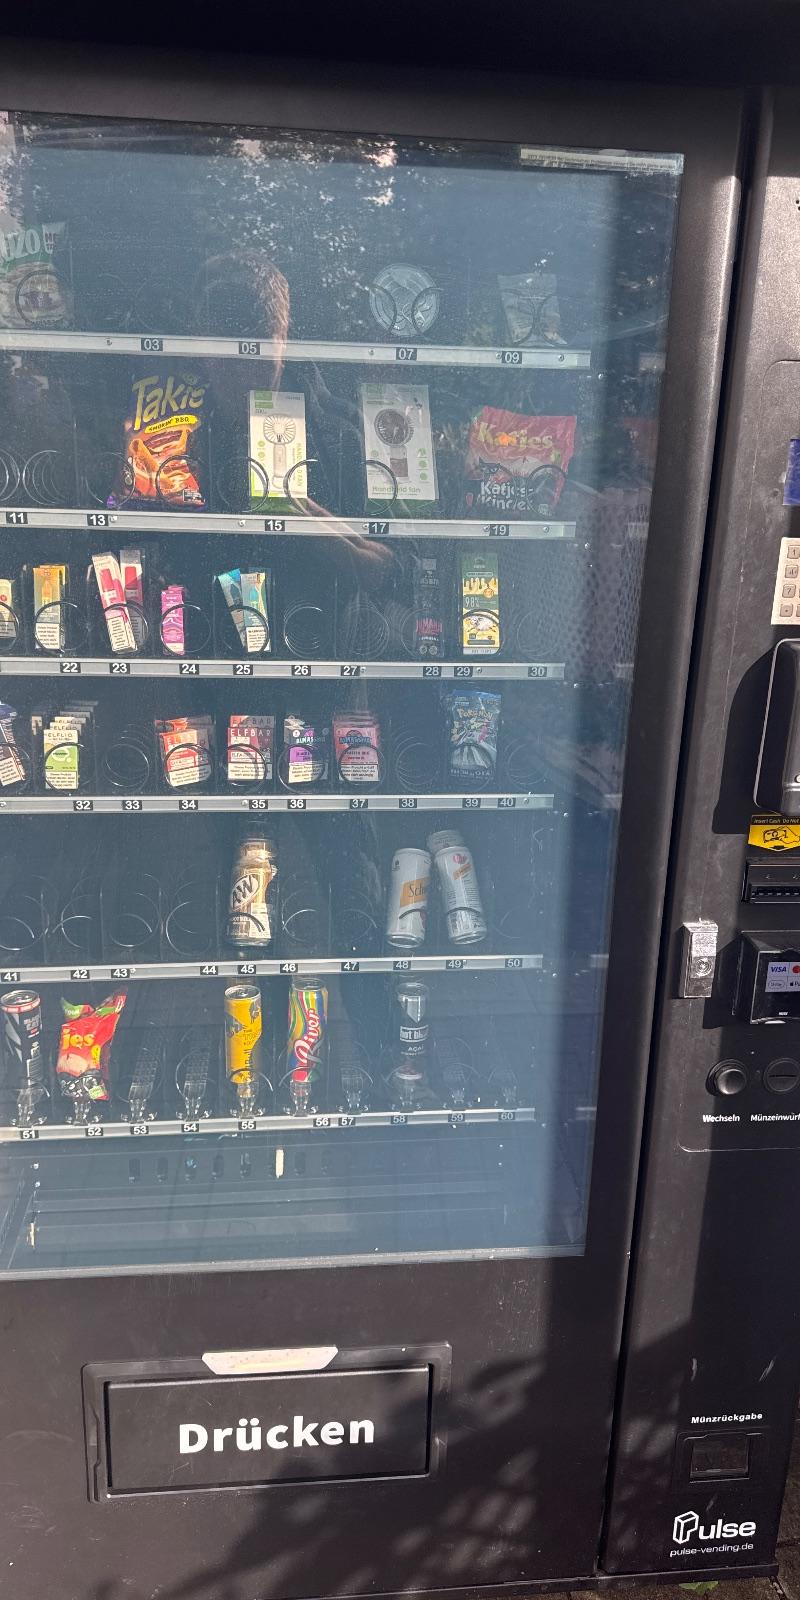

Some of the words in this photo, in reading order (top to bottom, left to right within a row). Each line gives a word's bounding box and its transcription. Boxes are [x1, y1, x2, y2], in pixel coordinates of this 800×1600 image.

[143, 339, 160, 351] 03
[241, 342, 257, 355] 05
[398, 347, 415, 360] 07
[504, 351, 520, 363] 09
[10, 512, 25, 523] 11
[89, 515, 106, 525] 13
[267, 520, 283, 531] 15
[371, 523, 387, 533] 17
[492, 525, 507, 536] 19
[62, 663, 78, 673] 22
[112, 664, 127, 673] 23
[181, 664, 197, 674] 24
[236, 665, 251, 675] 25
[294, 665, 309, 675] 26
[343, 666, 358, 675] 27
[425, 667, 440, 676] 28
[456, 667, 471, 677] 29
[531, 667, 545, 677] 30
[76, 800, 91, 810] 32
[125, 800, 140, 810] 33
[181, 800, 197, 810] 34
[251, 799, 266, 809] 35
[290, 799, 304, 808] 36
[351, 799, 366, 808] 37
[401, 799, 415, 808] 38
[465, 798, 479, 808] 39
[500, 798, 514, 807] 40
[282, 963, 296, 973] 46
[343, 961, 357, 971] 47
[395, 960, 409, 969] 48
[447, 959, 461, 969] 49
[507, 958, 520, 968] 50
[73, 969, 88, 979] 42
[113, 968, 128, 978] 43
[202, 965, 217, 974] 44
[240, 964, 255, 974] 45
[3, 971, 18, 981] 41
[392, 1114, 406, 1123] 58
[450, 1113, 463, 1122] 59
[500, 1112, 514, 1120] 60
[702, 1114, 740, 1123] Wechseln
[241, 1120, 255, 1130] 55
[315, 1117, 329, 1126] 56
[340, 1117, 354, 1126] 57
[88, 1127, 102, 1136] 52
[133, 1126, 147, 1135] 53
[183, 1123, 197, 1132] 54
[22, 1130, 36, 1139] 51
[691, 1412, 763, 1425] Münzrückgabe
[178, 1415, 376, 1454] Drücken
[669, 1542, 754, 1557] pulse-vending.de
